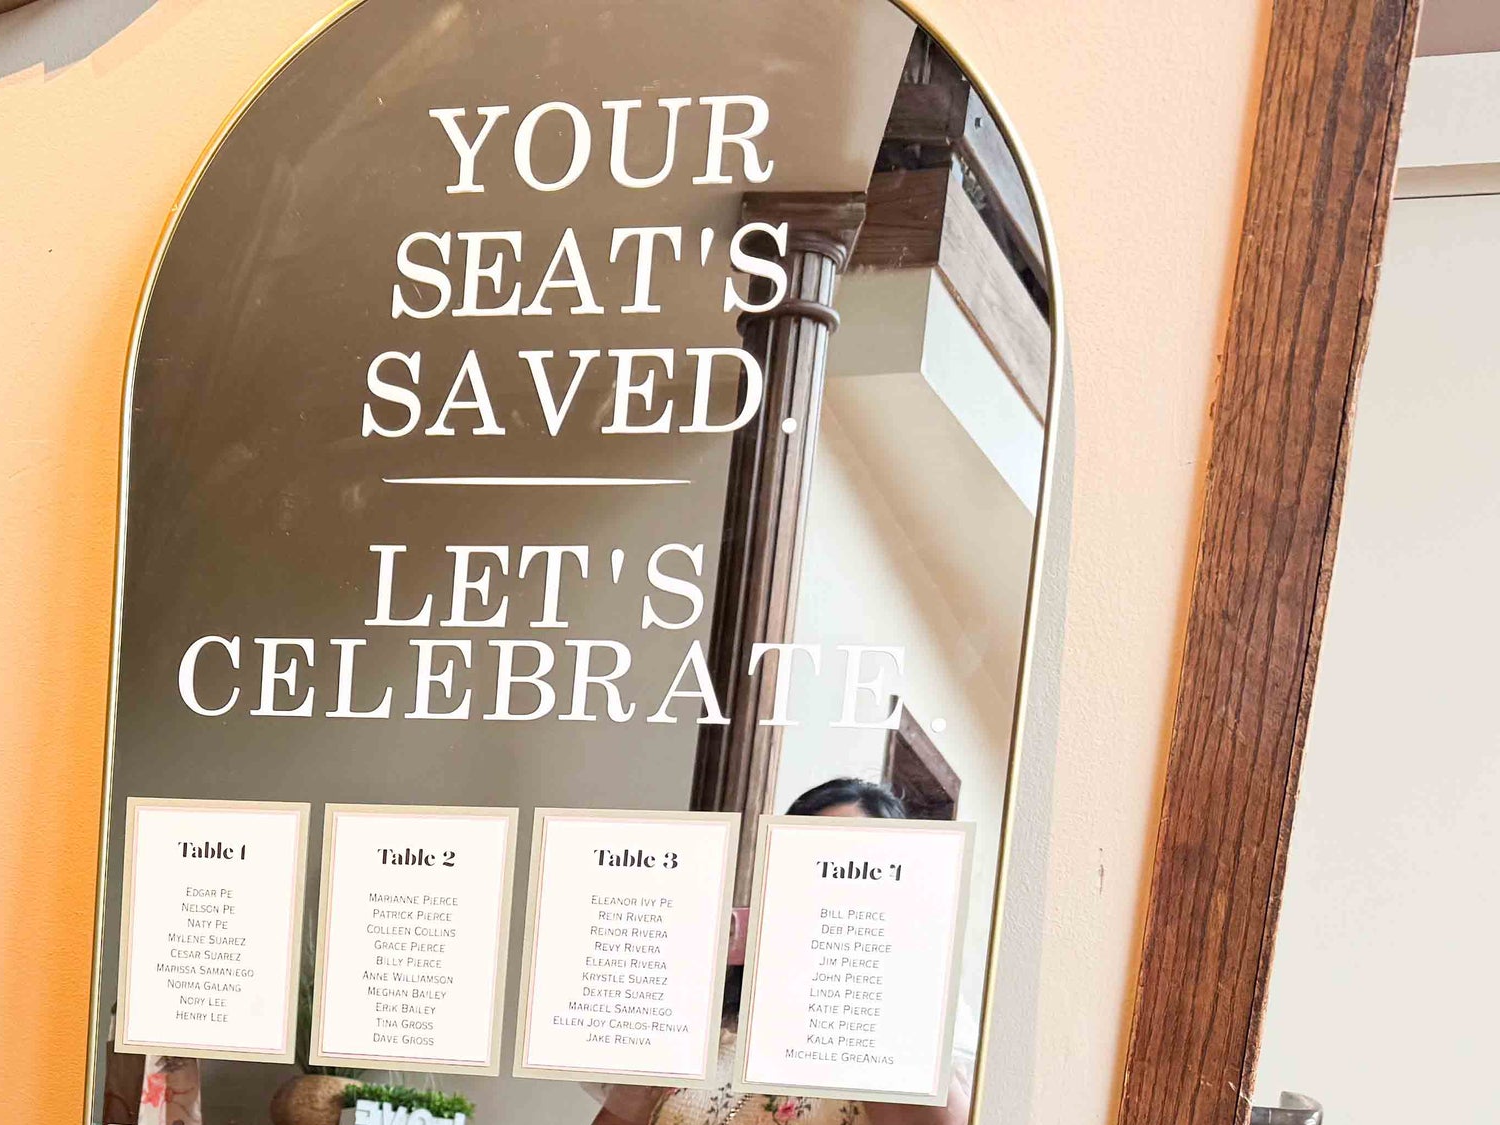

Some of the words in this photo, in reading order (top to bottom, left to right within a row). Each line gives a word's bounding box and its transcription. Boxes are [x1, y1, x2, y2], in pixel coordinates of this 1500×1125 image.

[428, 94, 775, 195] YOUR
[391, 222, 790, 319] SEAT'S
[361, 346, 798, 438] SAVED.
[363, 543, 706, 630] LET'S
[177, 635, 948, 734] CELEBRATE.
[178, 840, 234, 862] Table
[241, 844, 245, 860] 1
[377, 848, 436, 866] Table
[442, 849, 457, 867] 2
[594, 849, 655, 868] Table
[663, 850, 678, 869] 3
[816, 861, 882, 880] Table
